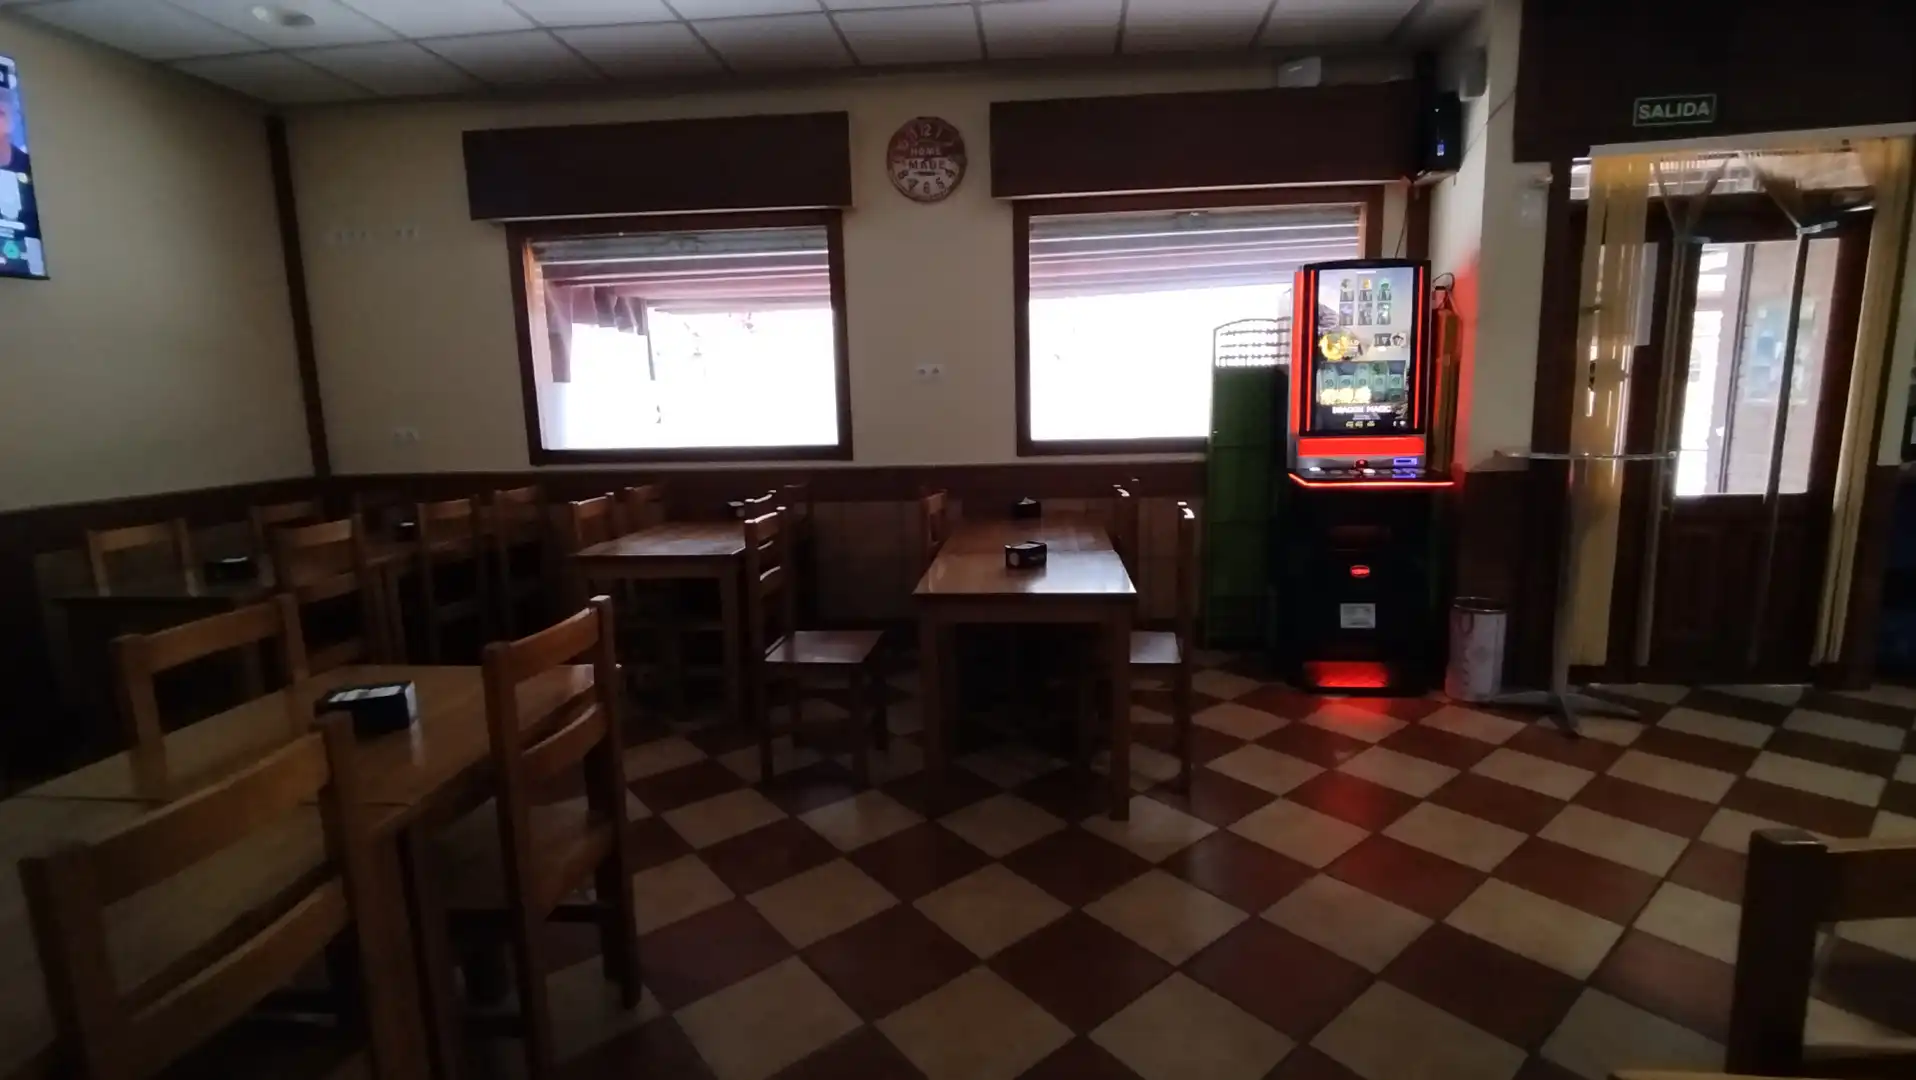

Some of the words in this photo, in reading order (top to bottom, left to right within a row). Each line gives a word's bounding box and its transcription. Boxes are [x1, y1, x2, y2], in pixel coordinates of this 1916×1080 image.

[1638, 101, 1710, 120] SALIDA
[910, 146, 941, 156] HOME
[909, 160, 946, 169] MADE
